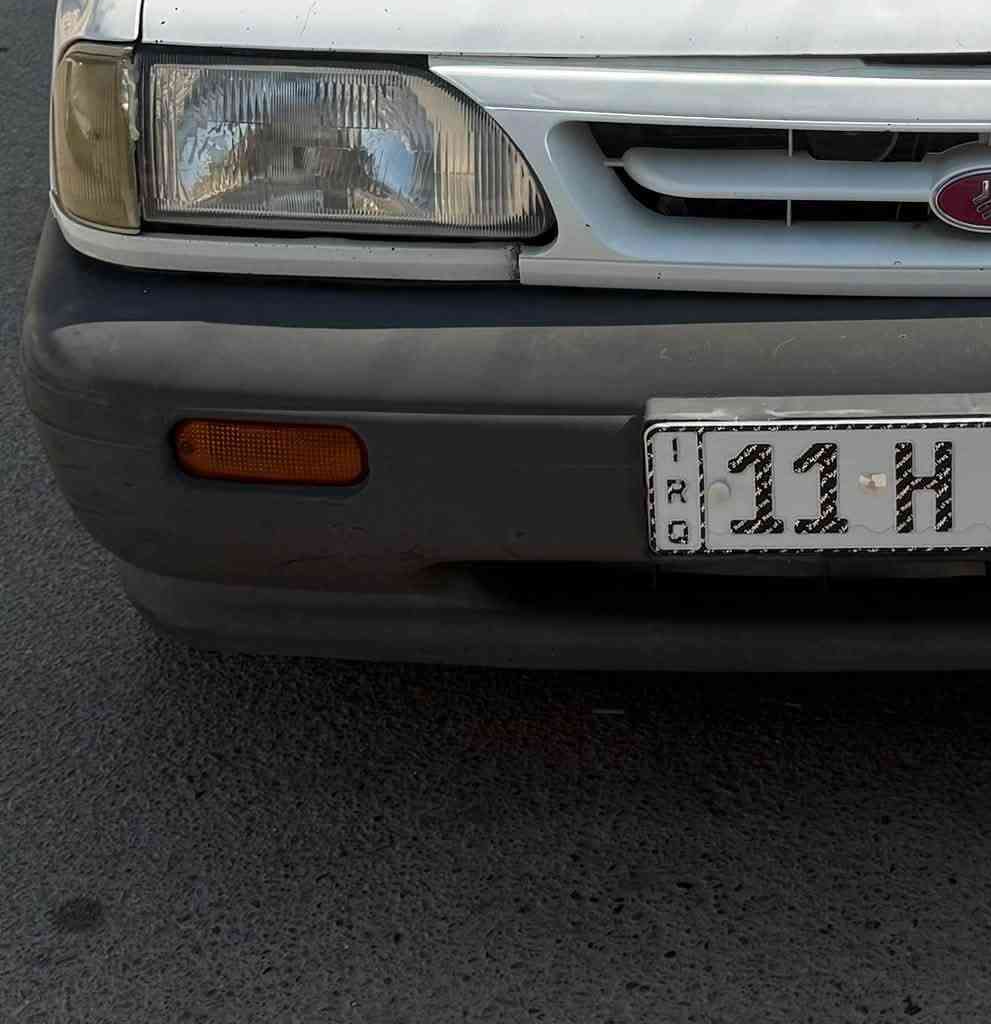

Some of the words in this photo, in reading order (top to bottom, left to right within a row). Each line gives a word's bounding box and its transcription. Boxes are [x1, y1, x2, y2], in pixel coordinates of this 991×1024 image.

[666, 437, 690, 546] IRQ
[727, 441, 850, 535] 11
[894, 440, 953, 534] H
